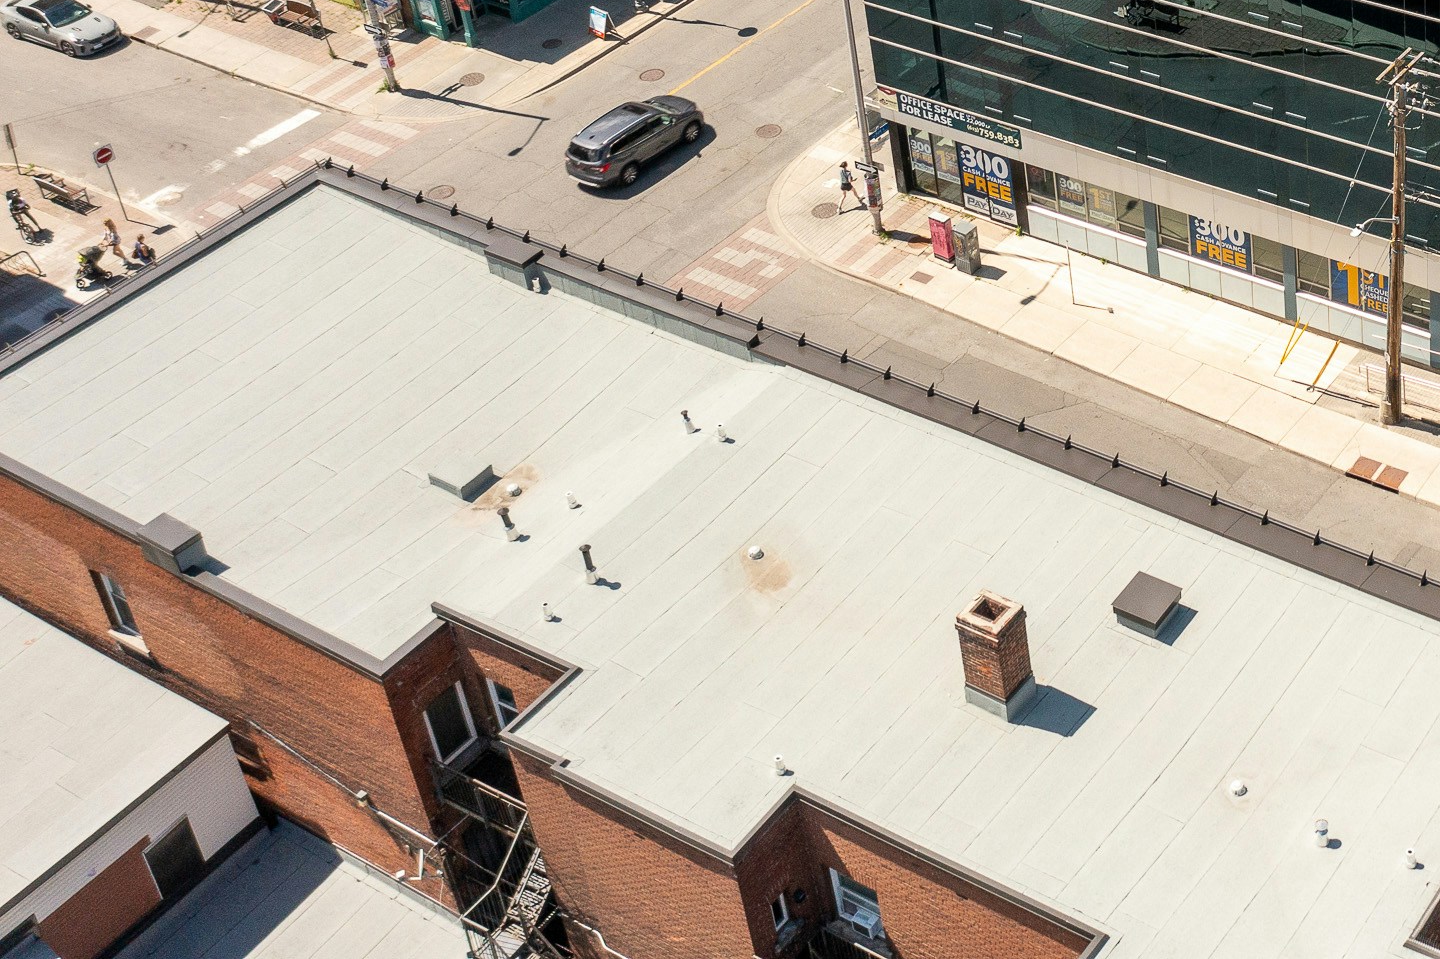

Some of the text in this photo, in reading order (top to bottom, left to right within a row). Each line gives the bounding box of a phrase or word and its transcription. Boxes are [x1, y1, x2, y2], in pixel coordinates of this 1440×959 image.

[900, 94, 933, 111] OFFICE
[934, 104, 966, 121] SPACE
[901, 103, 953, 127] FOR LEASE
[960, 145, 1009, 179] $300
[962, 166, 980, 176] CASH
[963, 172, 1012, 202] FREE
[1194, 217, 1245, 246] $300
[1196, 234, 1246, 254] CASH ADVANCE
[1196, 240, 1247, 268] FREE
